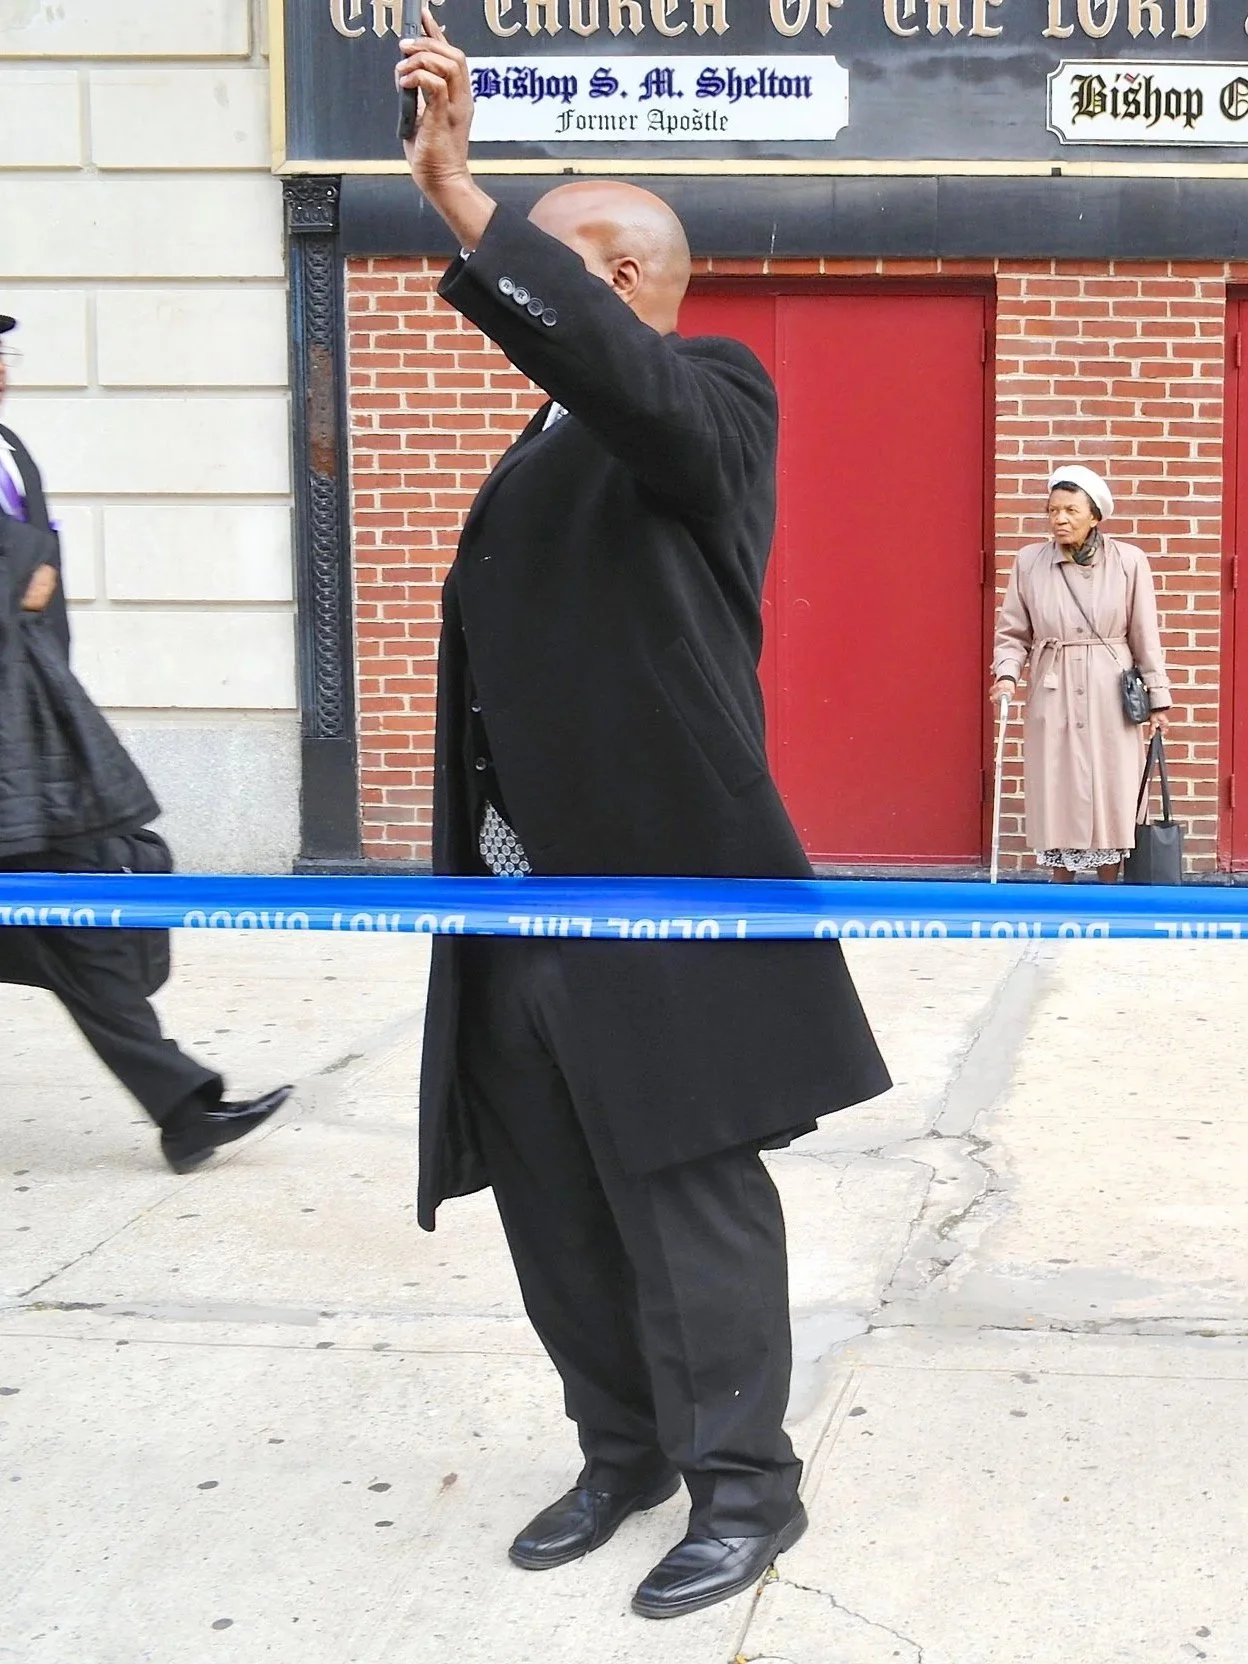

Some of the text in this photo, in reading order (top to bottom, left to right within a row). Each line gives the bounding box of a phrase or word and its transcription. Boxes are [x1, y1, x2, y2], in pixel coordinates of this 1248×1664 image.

[484, 0, 731, 38] CHURCH
[769, 0, 843, 38] OF
[882, 0, 1003, 38] THE
[1042, 0, 1208, 39] LORD
[471, 66, 813, 105] Bishop S. M. Shelton
[1070, 72, 1204, 127] Bishop
[555, 108, 729, 134] Former Apostle
